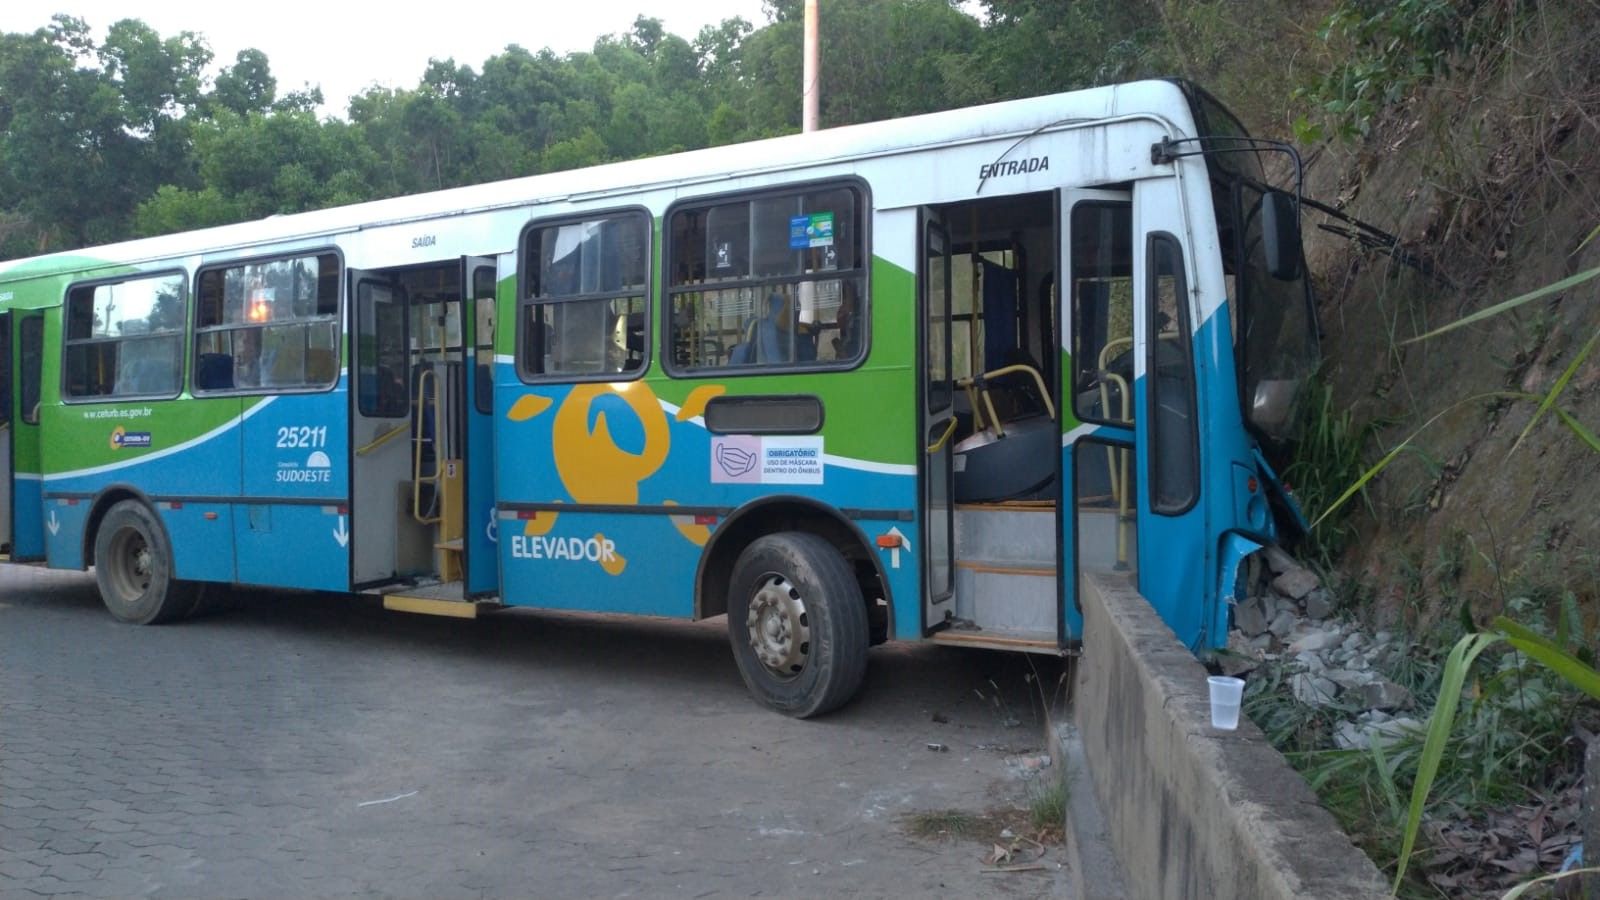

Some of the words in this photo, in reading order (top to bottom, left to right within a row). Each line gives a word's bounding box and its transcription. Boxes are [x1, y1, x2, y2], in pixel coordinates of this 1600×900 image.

[979, 156, 1049, 180] ENTRADA
[276, 425, 327, 448] 25211
[768, 448, 815, 457] OBRIGATÓRIO
[788, 458, 817, 466] MÁSCARA
[276, 469, 331, 482] SUDOESTE
[511, 535, 616, 563] ELEVADOR
